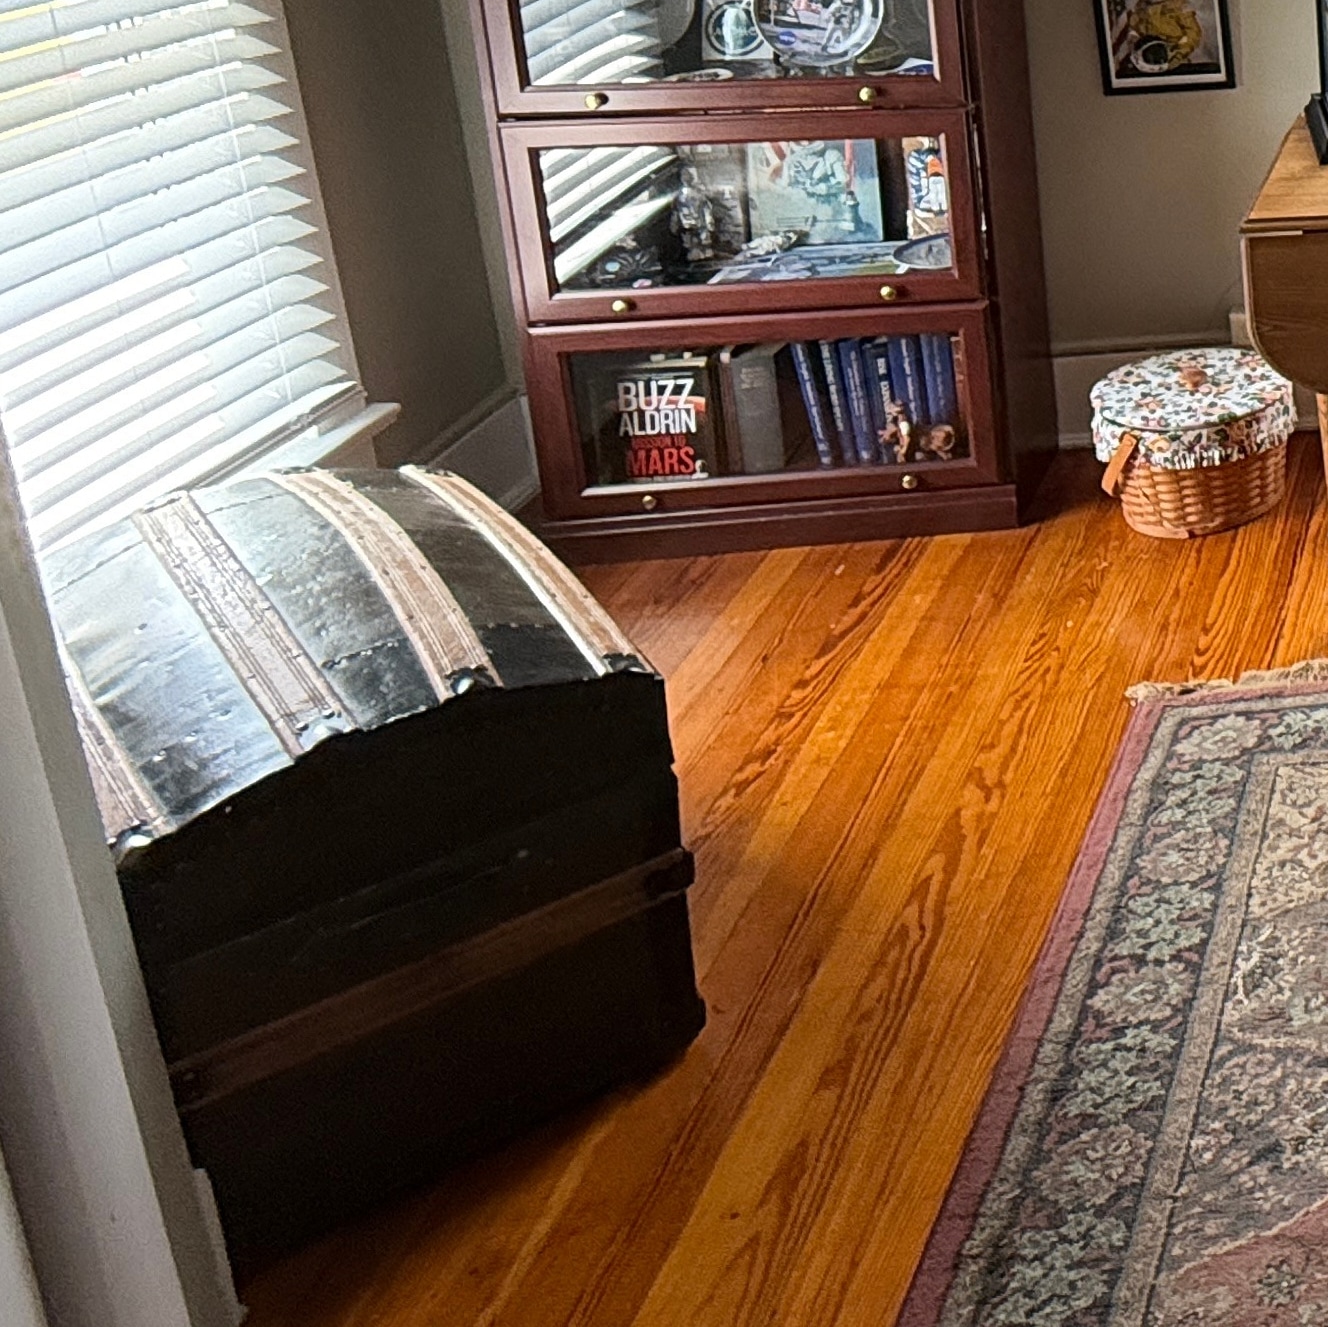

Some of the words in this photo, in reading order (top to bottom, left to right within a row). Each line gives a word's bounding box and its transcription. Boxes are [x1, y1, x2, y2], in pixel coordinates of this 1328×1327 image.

[617, 378, 694, 412] BUZZ
[619, 409, 697, 437] ALDRIN
[626, 446, 695, 476] MARS
